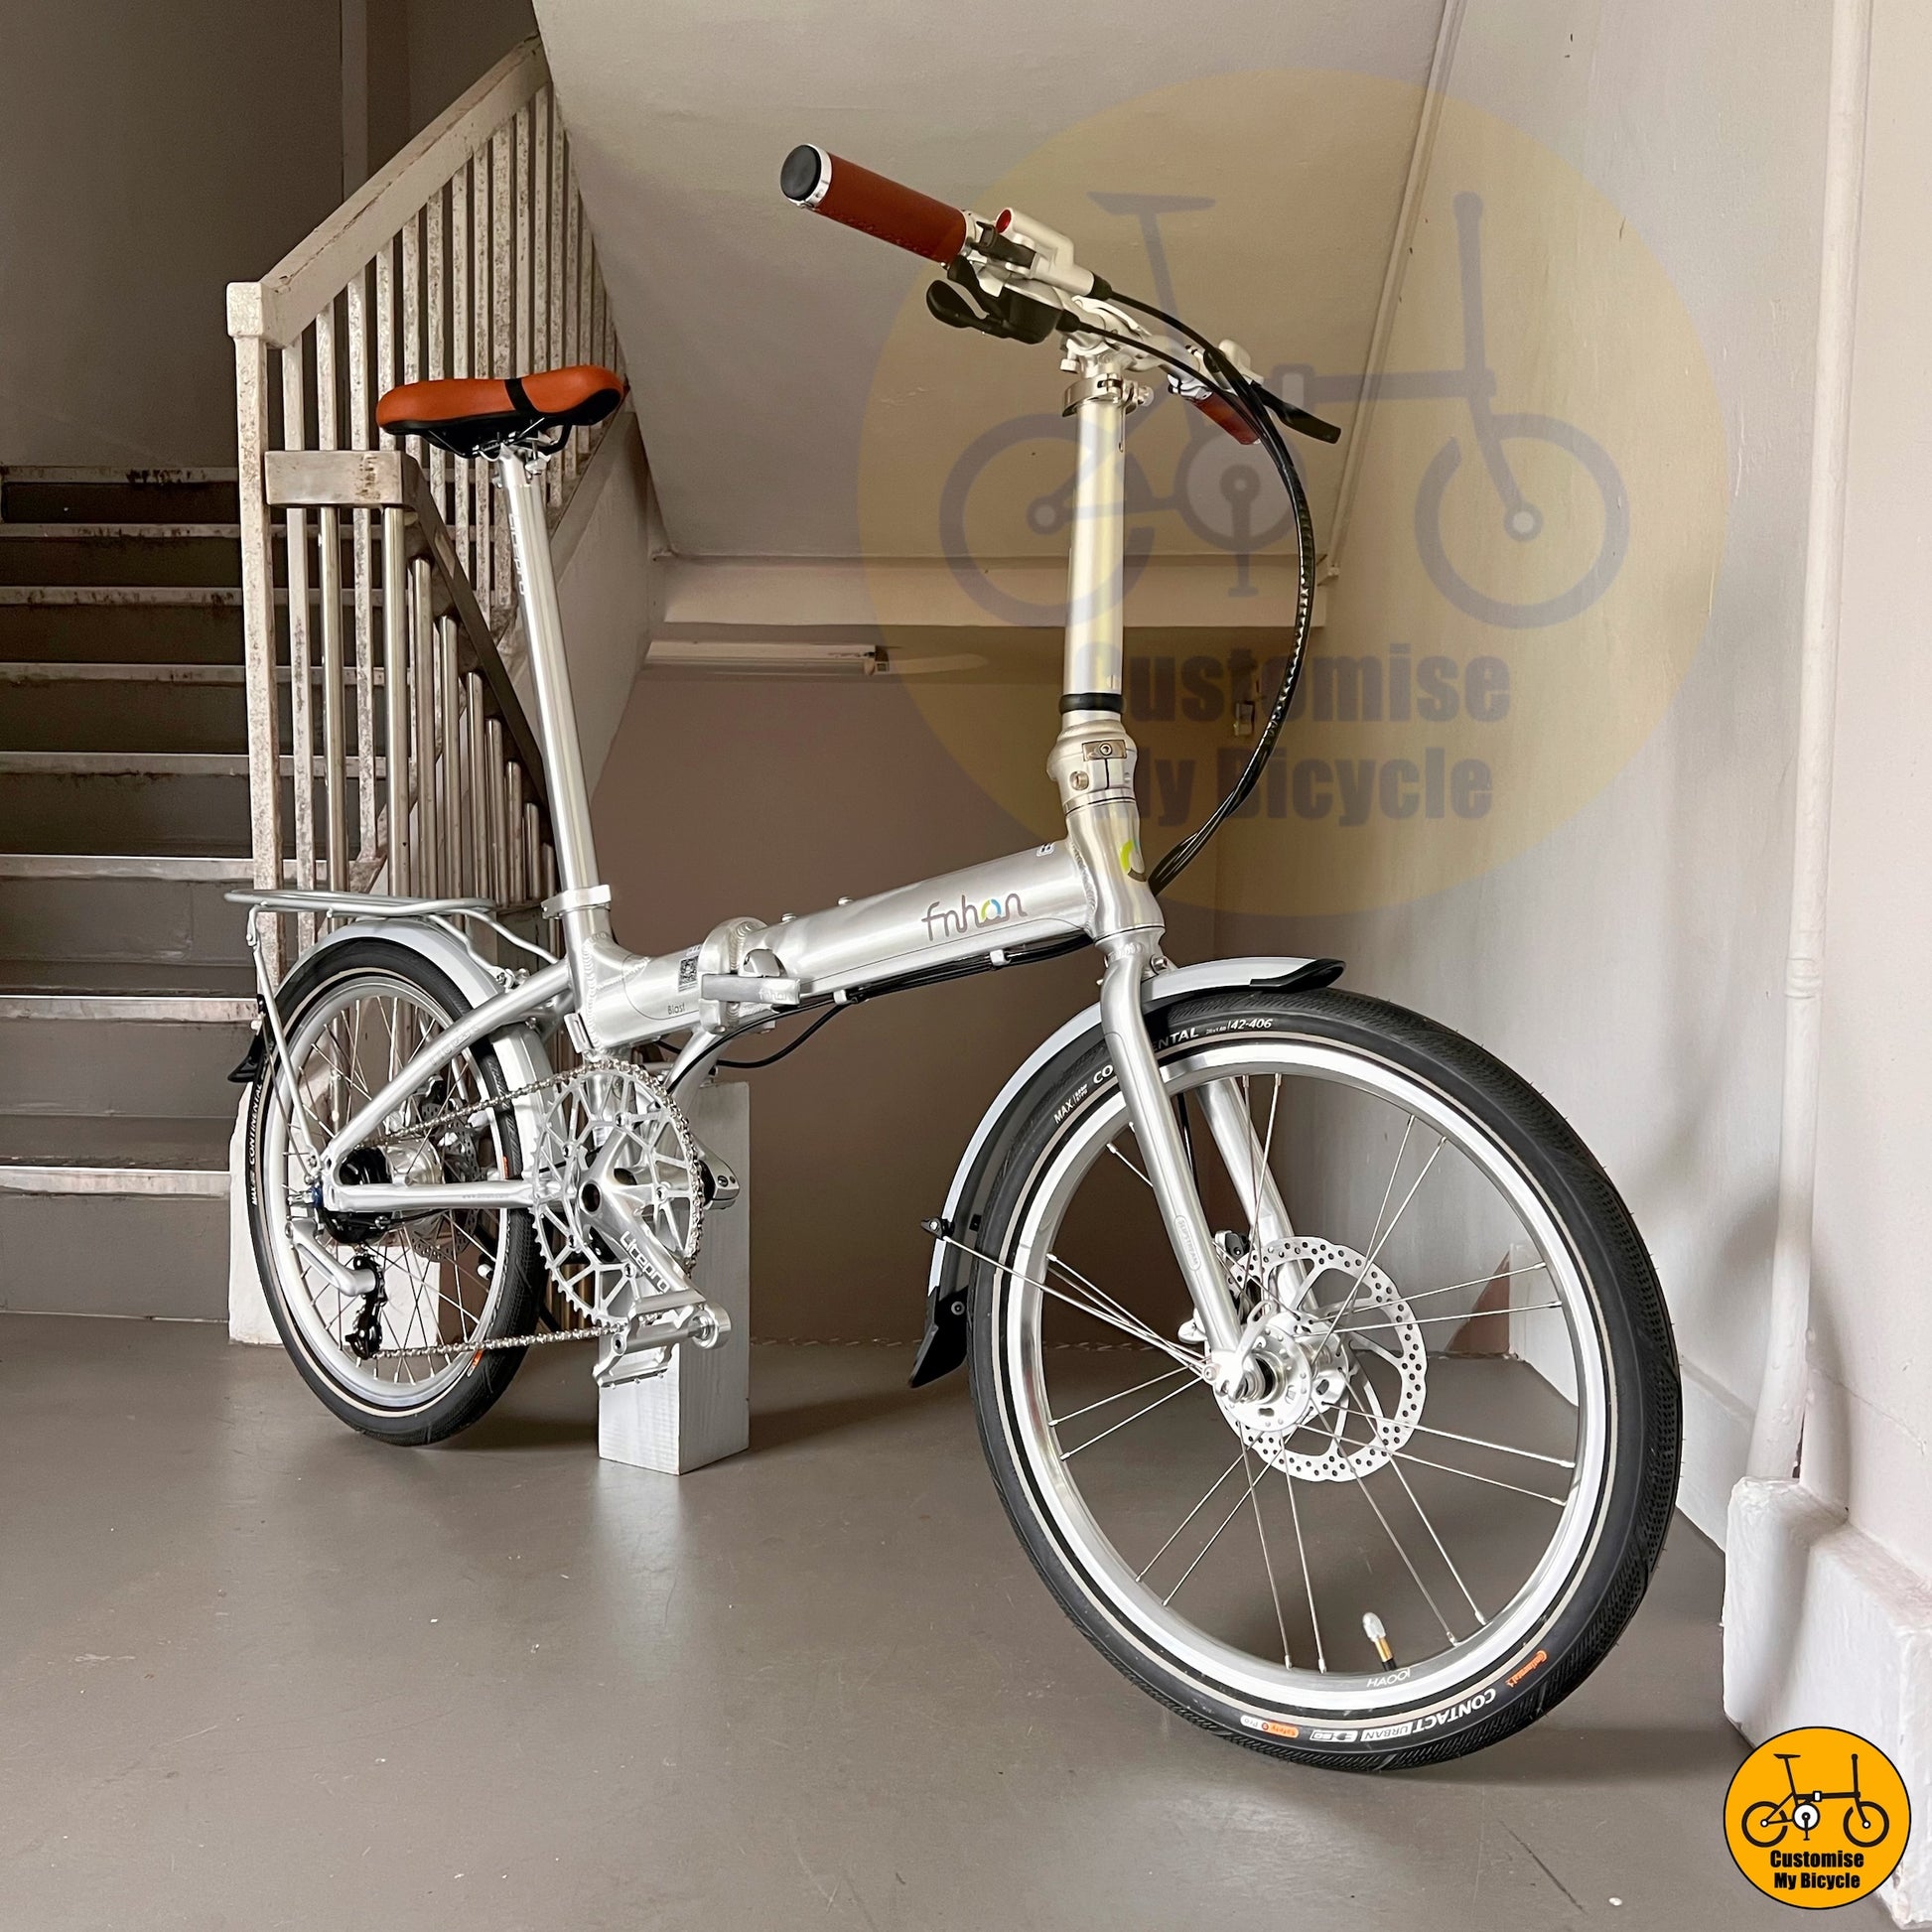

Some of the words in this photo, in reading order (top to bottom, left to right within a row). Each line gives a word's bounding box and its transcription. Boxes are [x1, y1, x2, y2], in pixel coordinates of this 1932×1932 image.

[250, 1082, 262, 1166] CONTINENTAL
[620, 1230, 671, 1294] Litepro
[1364, 1725, 1413, 1740] URBAN
[1413, 1688, 1496, 1732] CONTACT
